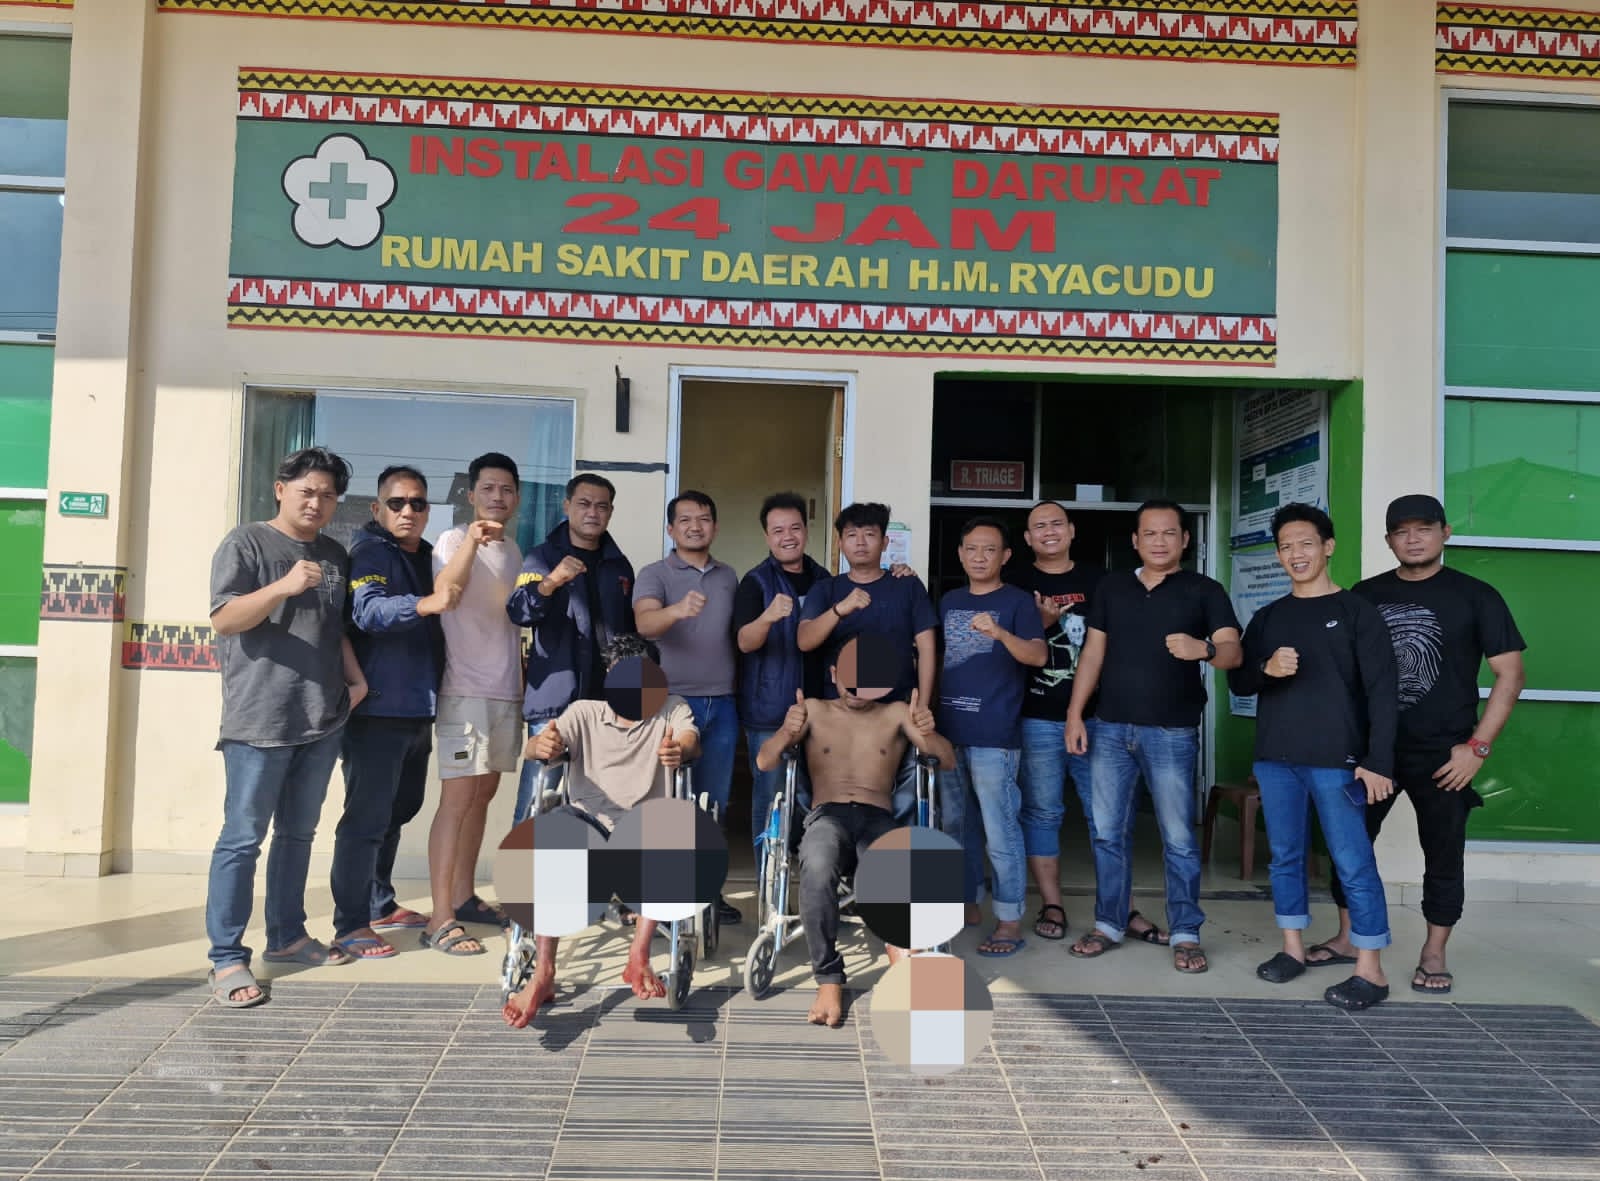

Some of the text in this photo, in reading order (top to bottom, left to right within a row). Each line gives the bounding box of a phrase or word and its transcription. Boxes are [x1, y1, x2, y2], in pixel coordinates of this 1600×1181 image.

[409, 135, 1221, 206] INSTALASI GAWAT DARURAT
[562, 192, 1056, 253] 24 JAM
[381, 236, 1215, 298] RUMAH SAKIT DAERAH H.M. RYACUDU
[975, 467, 1016, 486] TRIAGE
